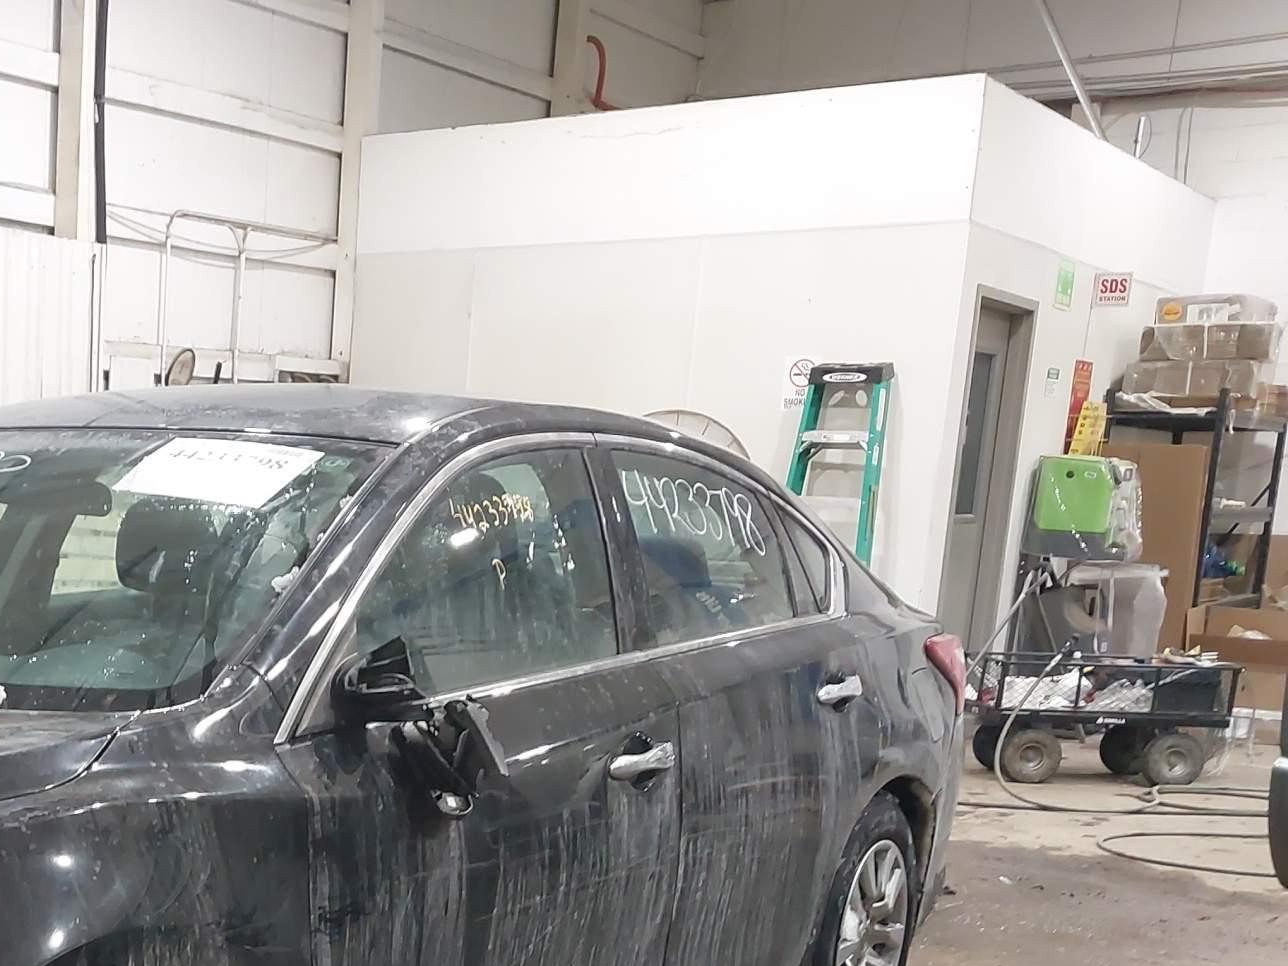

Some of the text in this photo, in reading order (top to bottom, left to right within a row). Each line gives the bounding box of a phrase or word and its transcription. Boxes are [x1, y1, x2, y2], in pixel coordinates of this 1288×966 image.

[1100, 278, 1128, 294] SDS
[795, 388, 806, 397] NO
[783, 397, 807, 407] SMOK
